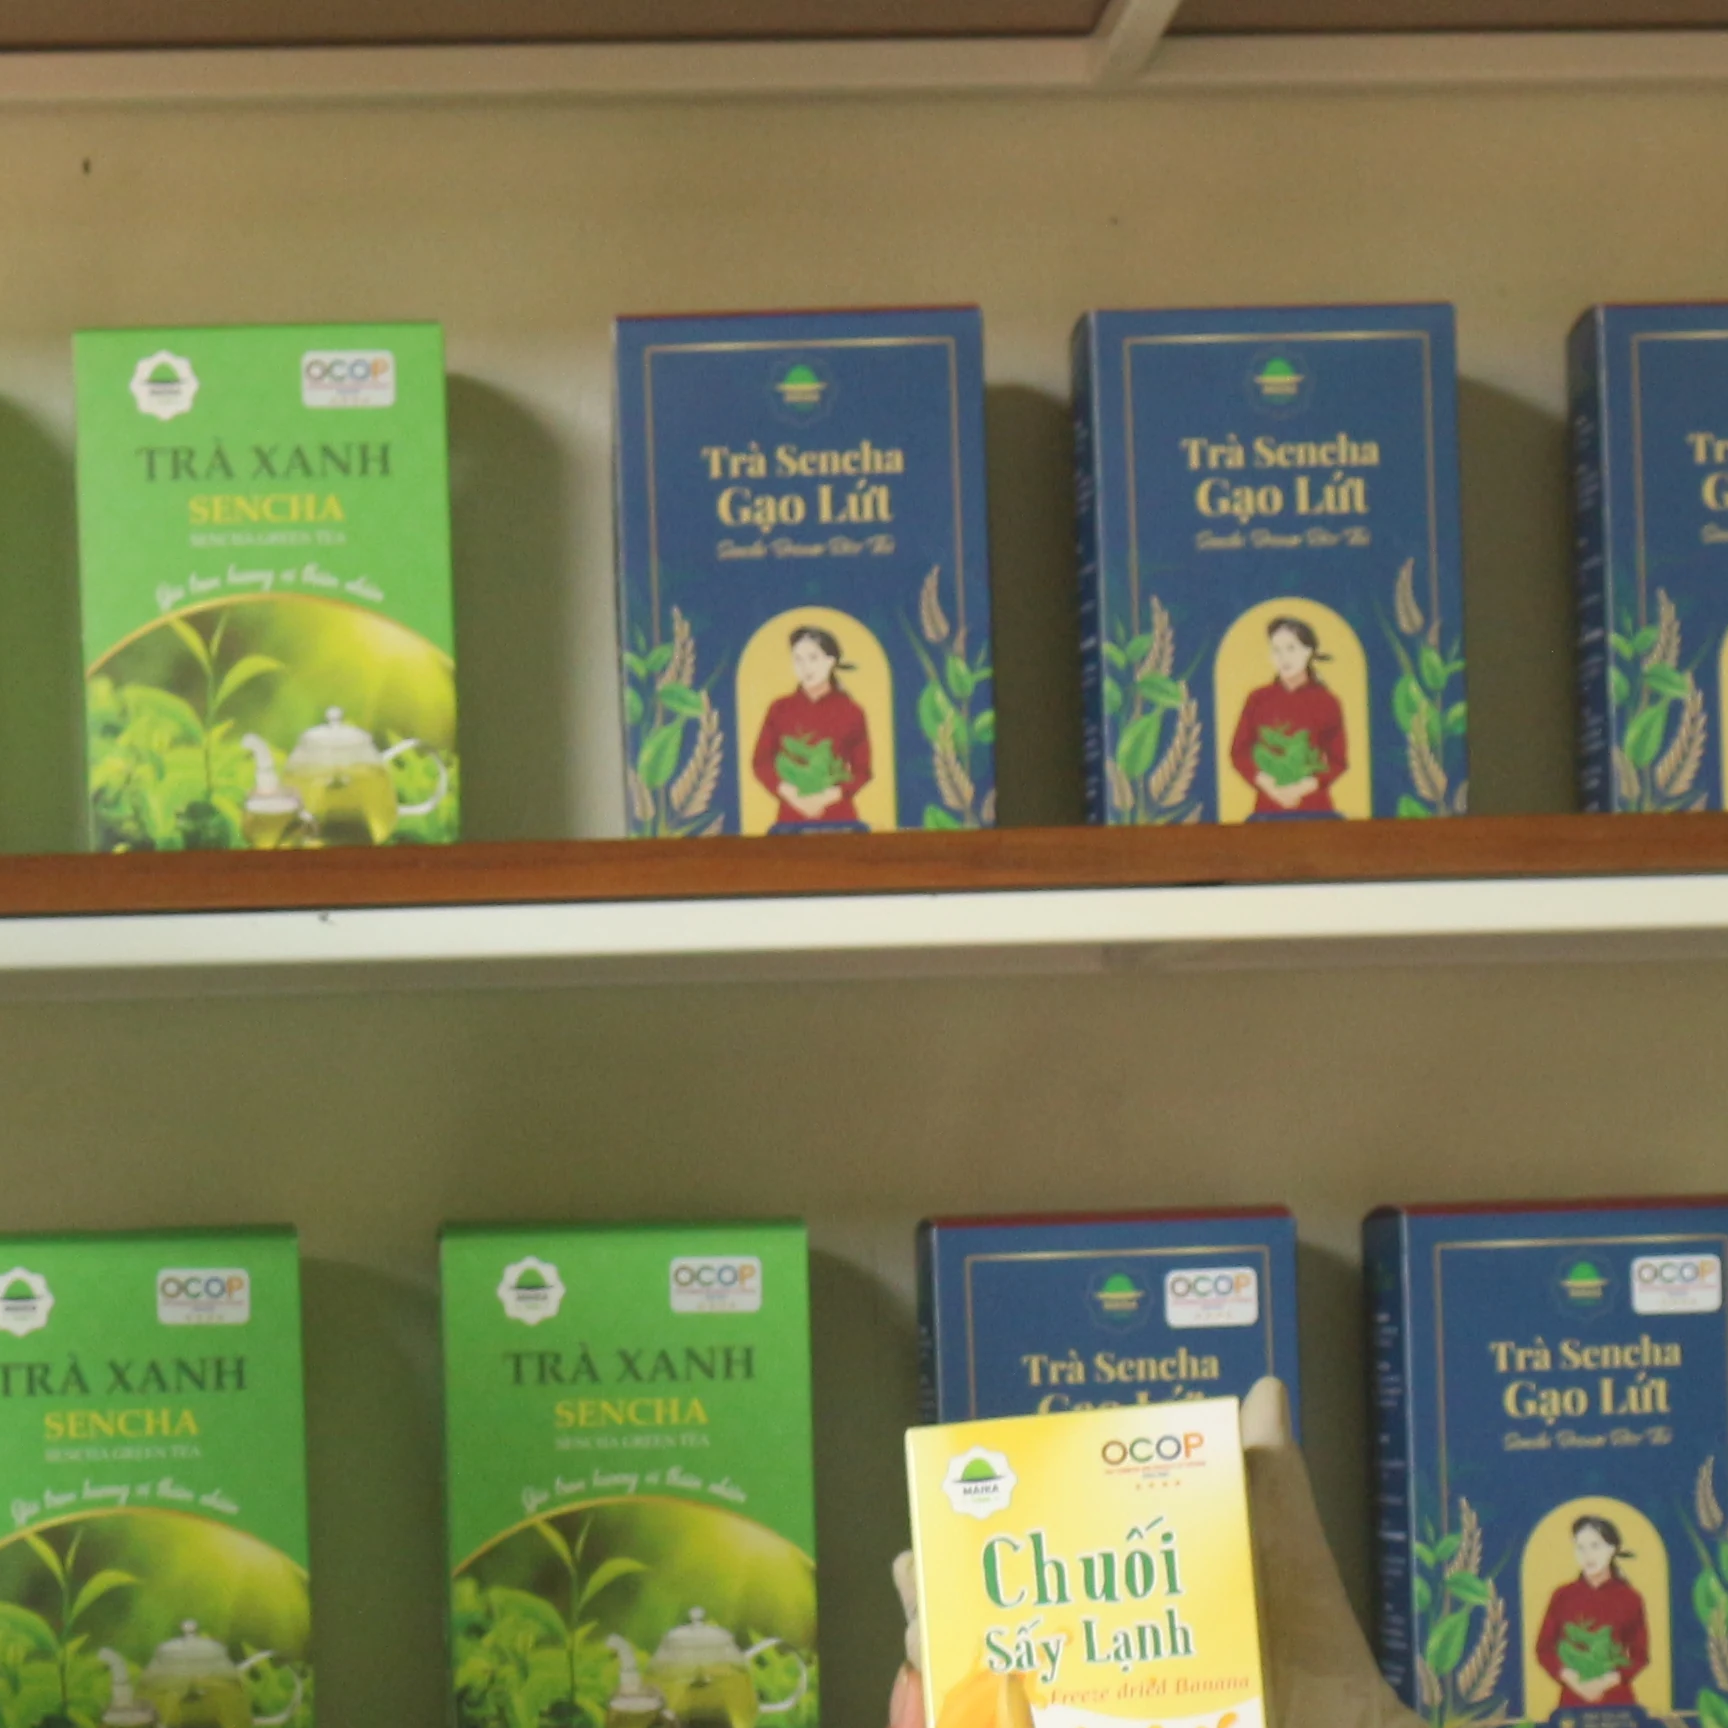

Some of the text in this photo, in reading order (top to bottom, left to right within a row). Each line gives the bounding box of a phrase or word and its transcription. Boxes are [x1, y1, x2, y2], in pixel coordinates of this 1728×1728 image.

[306, 357, 389, 383] OCOP
[136, 436, 393, 483] TRÀ XANH
[701, 439, 905, 480] Trà Sencha
[1180, 431, 1381, 470] Trà Sencha
[187, 493, 345, 525] SENCHA
[717, 486, 807, 533] Gạo
[1195, 476, 1284, 524] Gạo
[160, 1275, 245, 1300] OCOP
[674, 1264, 757, 1289] OCOP
[1170, 1274, 1252, 1298] OCOP
[1637, 1260, 1716, 1284] OCOP
[503, 1341, 756, 1386] TRÀ XANH
[1020, 1346, 1220, 1387] Trà Sencha
[1489, 1334, 1682, 1373] Trà Sencha
[106, 1354, 248, 1396] XANH
[554, 1396, 709, 1429] SENCHA
[1503, 1378, 1589, 1427] Gạo
[44, 1408, 200, 1441] SENCHA
[1101, 1432, 1205, 1466] OCOP
[962, 1483, 1000, 1496] MAIKA
[981, 1516, 1183, 1609] Chuối
[984, 1608, 1194, 1683] Sấy Lạnh
[1117, 1679, 1167, 1700] dried
[1175, 1676, 1249, 1696] Banana
